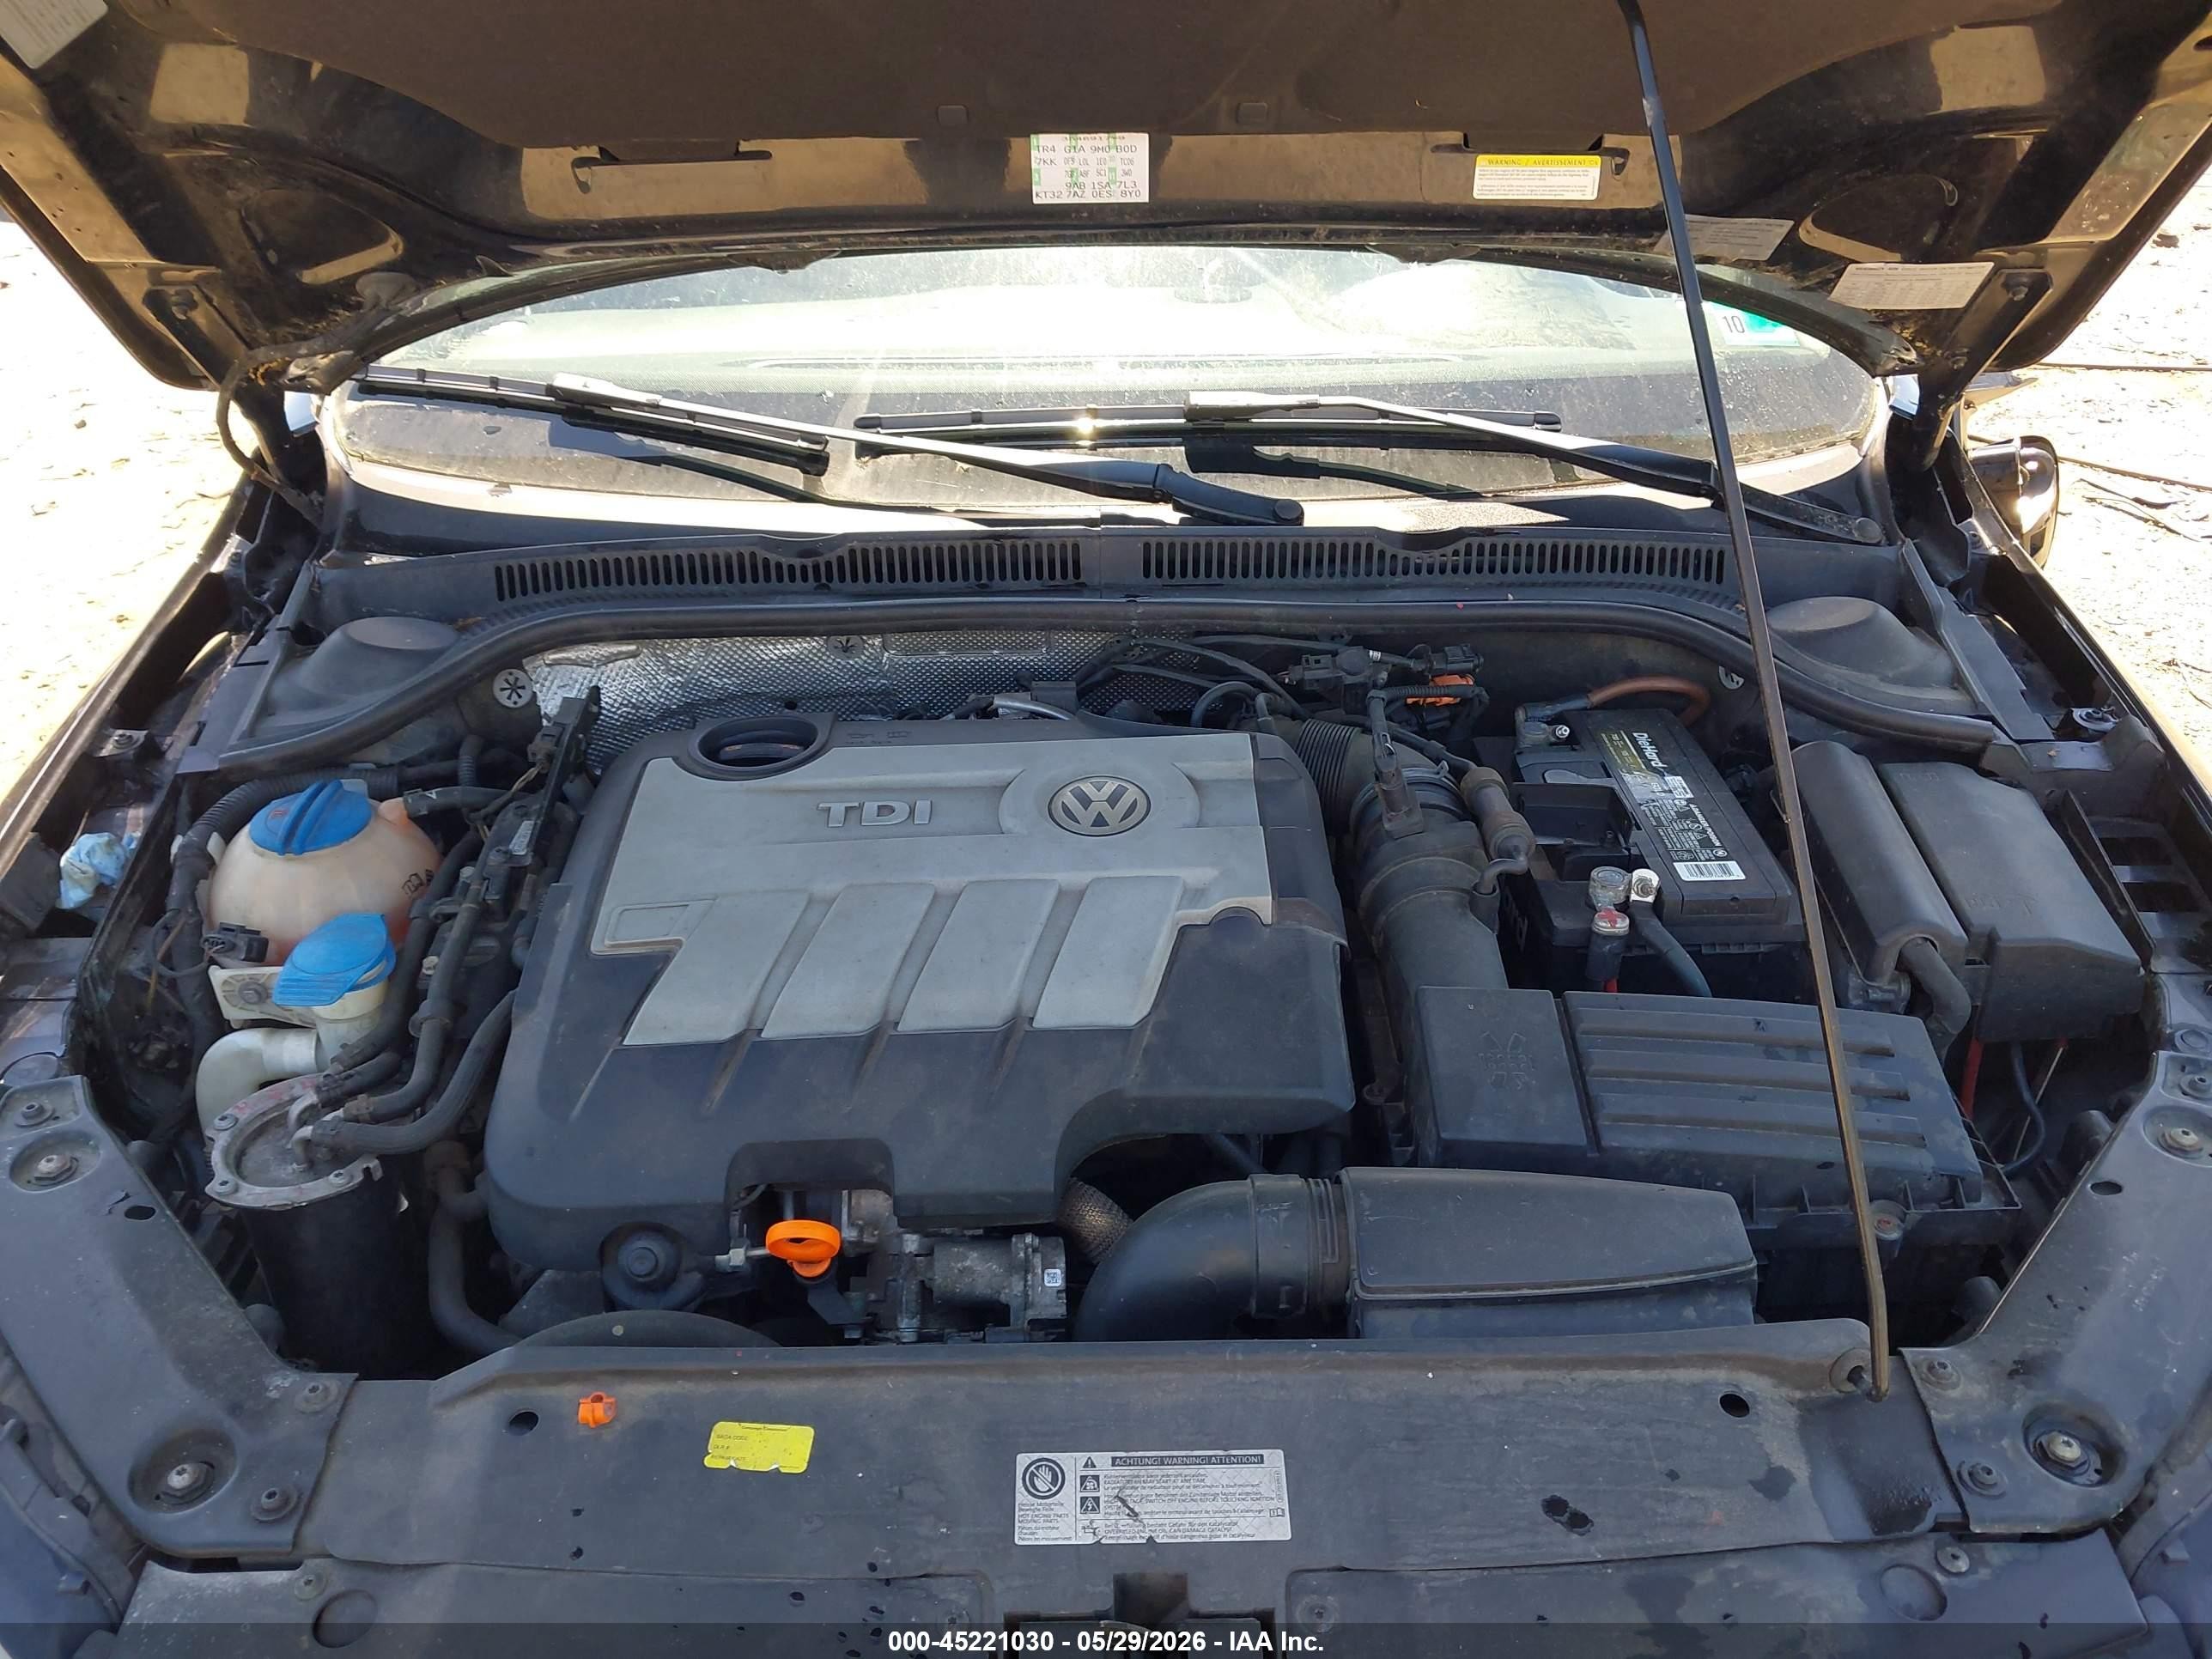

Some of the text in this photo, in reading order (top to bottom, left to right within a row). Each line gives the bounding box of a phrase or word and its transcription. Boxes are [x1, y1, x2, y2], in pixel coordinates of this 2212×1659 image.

[1632, 732, 1668, 767] DieHard
[817, 799, 933, 827] TDI
[1115, 1455, 1261, 1465] ACHTUNG! WARNING! ATTENTION!
